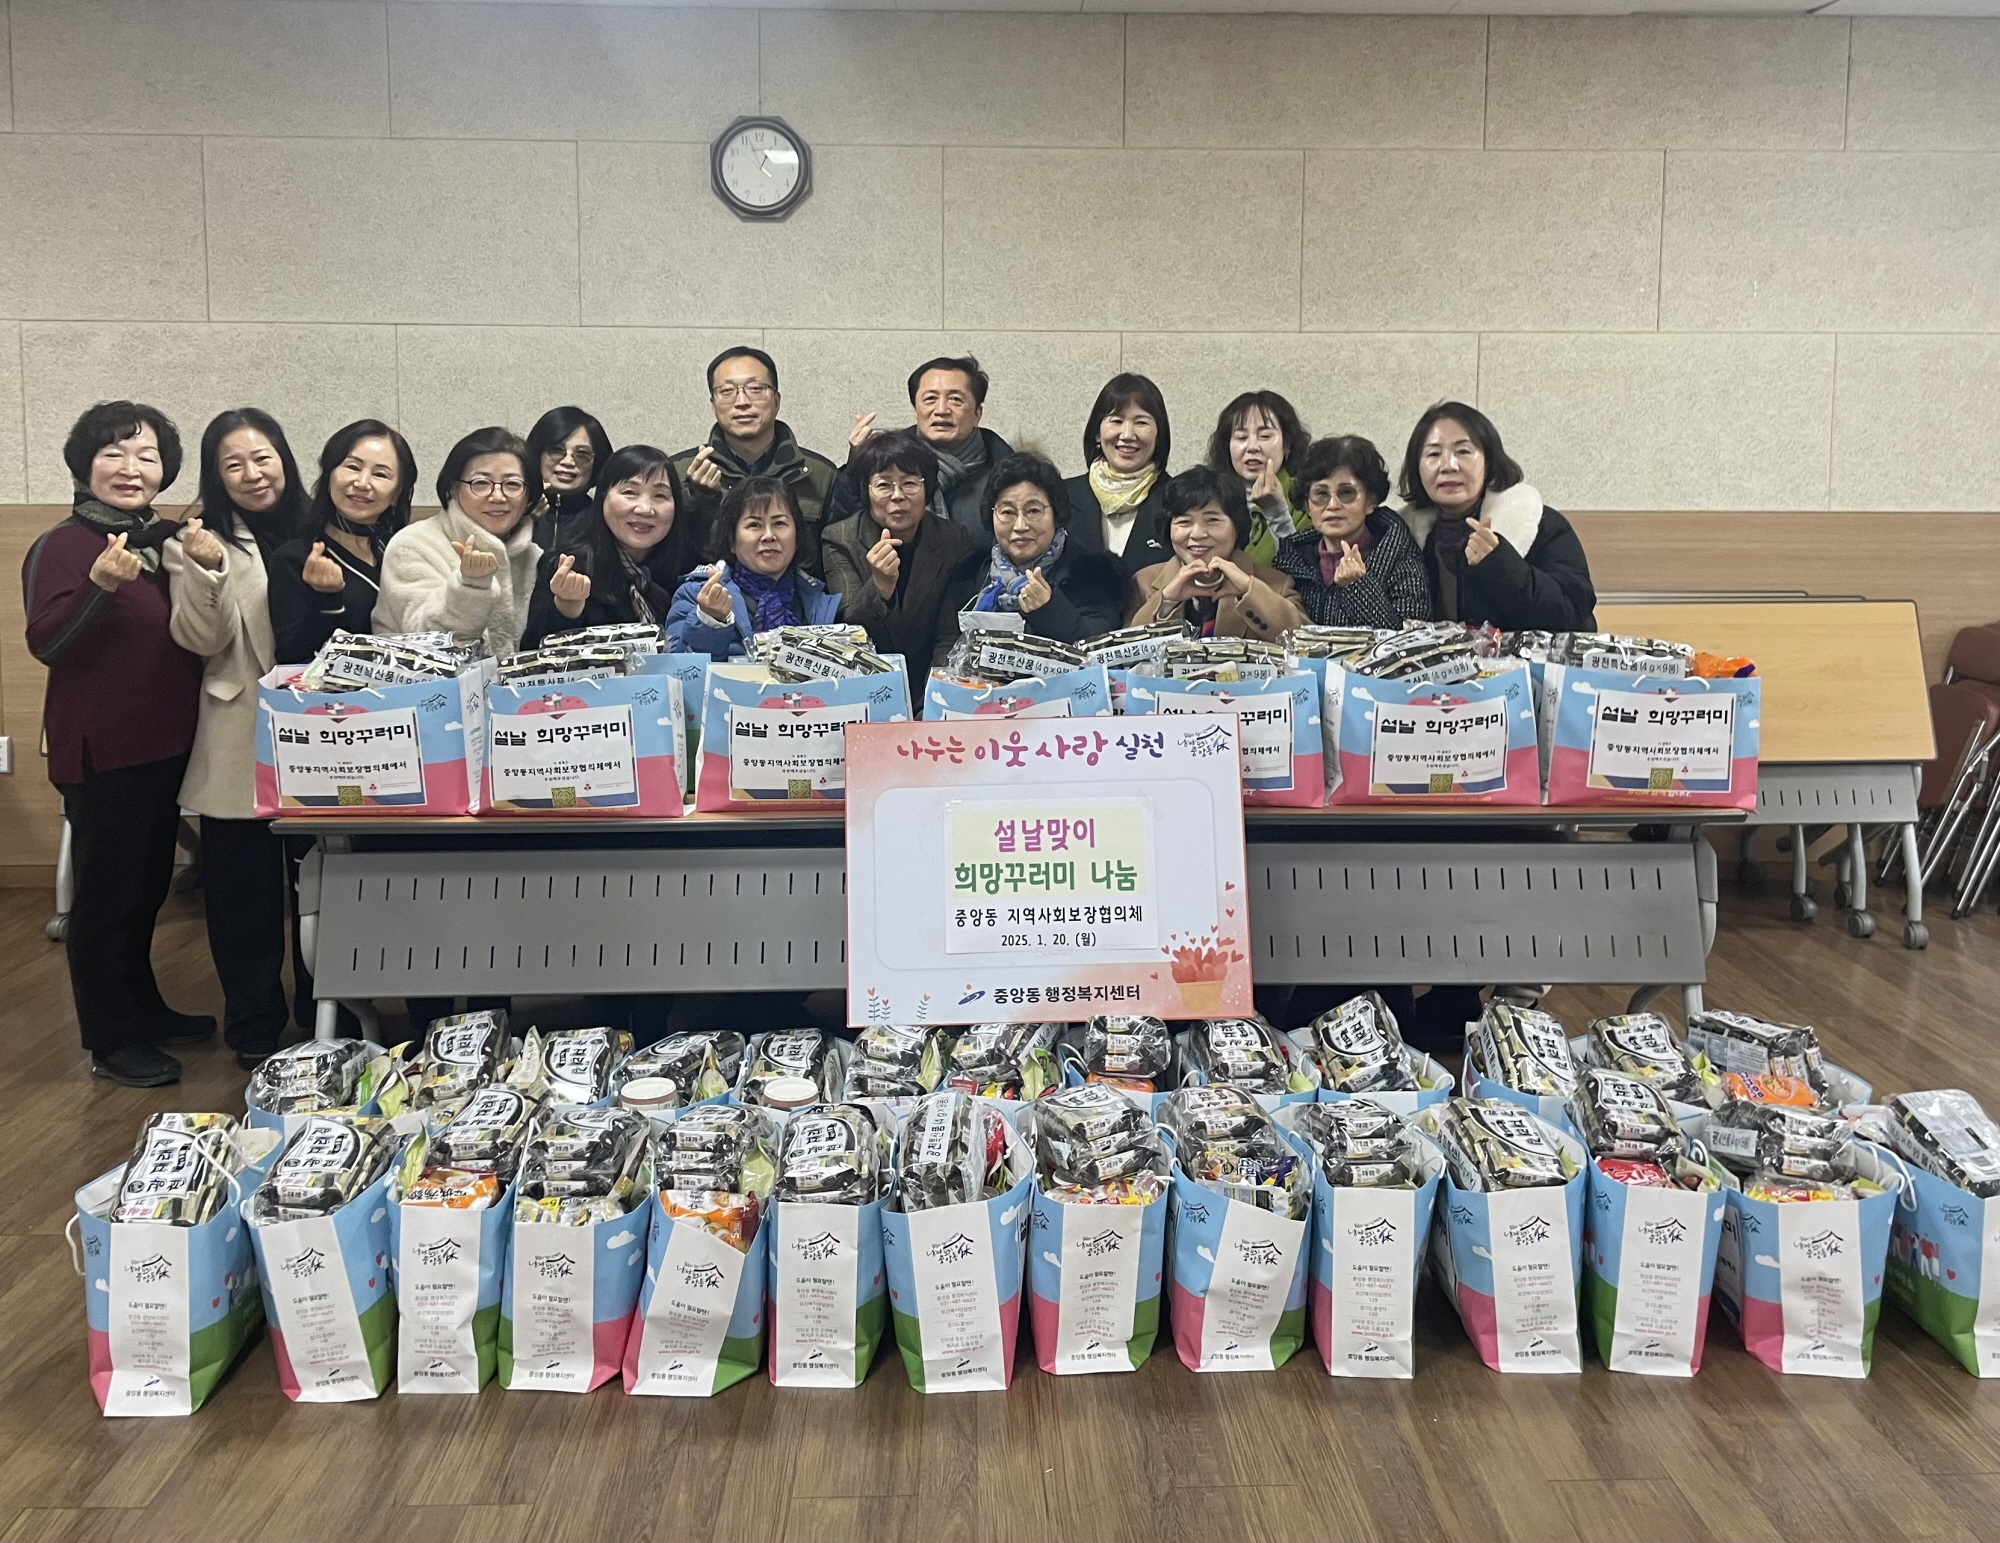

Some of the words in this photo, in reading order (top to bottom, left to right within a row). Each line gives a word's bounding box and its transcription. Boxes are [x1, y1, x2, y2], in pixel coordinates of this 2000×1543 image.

[741, 135, 748, 145] 11
[755, 132, 765, 142] 12
[1381, 718, 1416, 734] 설날
[1425, 712, 1503, 735] 희망꾸러미
[1602, 706, 1639, 724] 설날
[1648, 709, 1728, 725] 희망꾸러미
[278, 727, 310, 745] 설날
[320, 724, 412, 746] 희망꾸러미
[494, 730, 527, 747] 설날
[537, 721, 626, 743] 희망꾸러미
[735, 722, 768, 738] 설날
[897, 737, 965, 764] 나누는
[974, 731, 1027, 767] 이웃
[1035, 731, 1108, 766] 사랑
[1116, 732, 1165, 761] 실천
[994, 818, 1096, 852] 설날맞이
[954, 861, 1075, 894] 희망꾸러미
[1091, 860, 1137, 891] 나눔
[954, 909, 998, 927] 중앙동
[1007, 905, 1142, 924] 지역사회보장협의체
[1001, 933, 1031, 947] 2025.
[1037, 933, 1047, 946] 1.
[1052, 933, 1069, 946] 20.
[1075, 931, 1097, 948] (월)
[993, 987, 1041, 1004] 중앙동
[1045, 984, 1140, 1003] 행정복지센터
